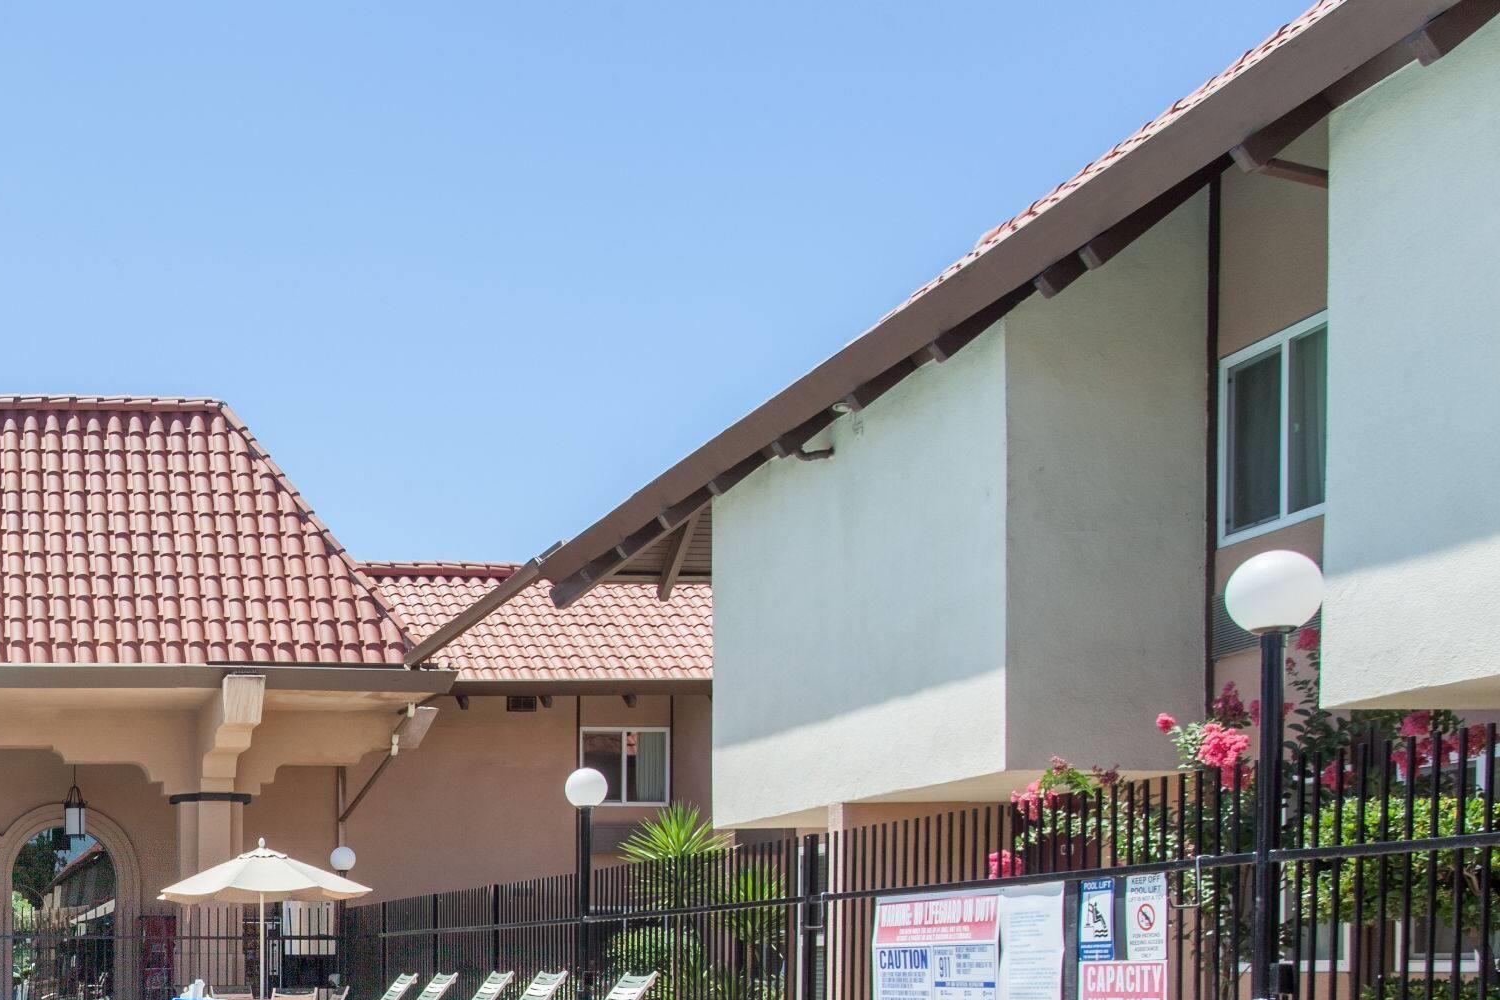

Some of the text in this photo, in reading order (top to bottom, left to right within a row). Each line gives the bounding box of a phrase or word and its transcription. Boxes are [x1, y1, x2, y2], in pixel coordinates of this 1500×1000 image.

[1083, 880, 1111, 891] POOL LIFT
[1131, 875, 1161, 885] KEEP OFF
[1130, 885, 1161, 895] POOL LIFT
[879, 949, 928, 970] CAUTION
[938, 956, 951, 978] 911
[1087, 965, 1162, 993] CAPACITY
